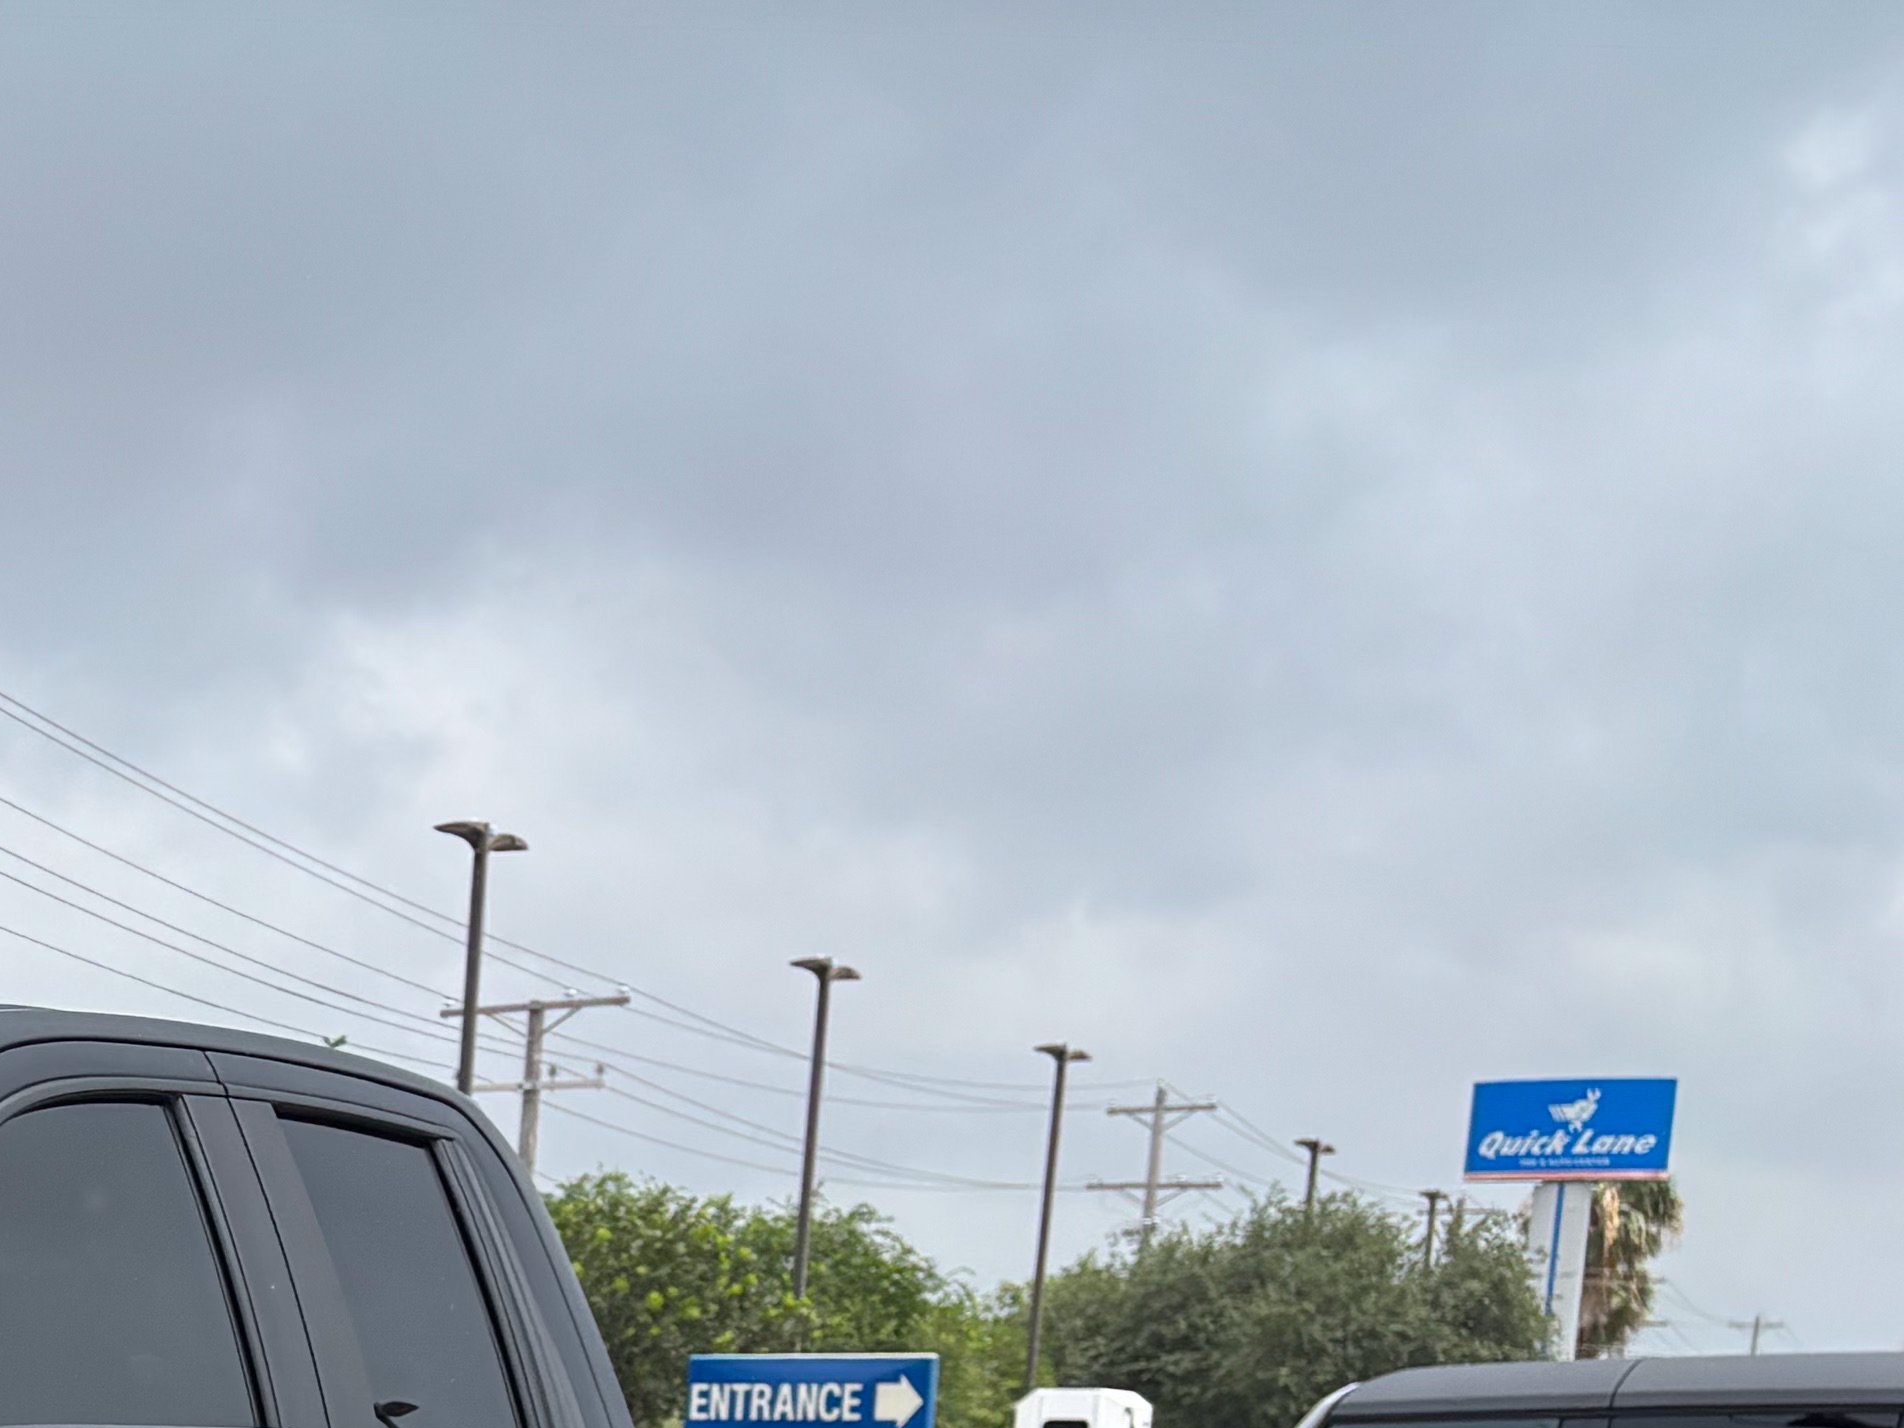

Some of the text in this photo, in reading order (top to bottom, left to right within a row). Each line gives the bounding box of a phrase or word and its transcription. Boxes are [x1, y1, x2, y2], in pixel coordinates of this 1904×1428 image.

[1478, 1129, 1658, 1160] Quick Lane
[689, 1382, 864, 1422] ENTRANCE
